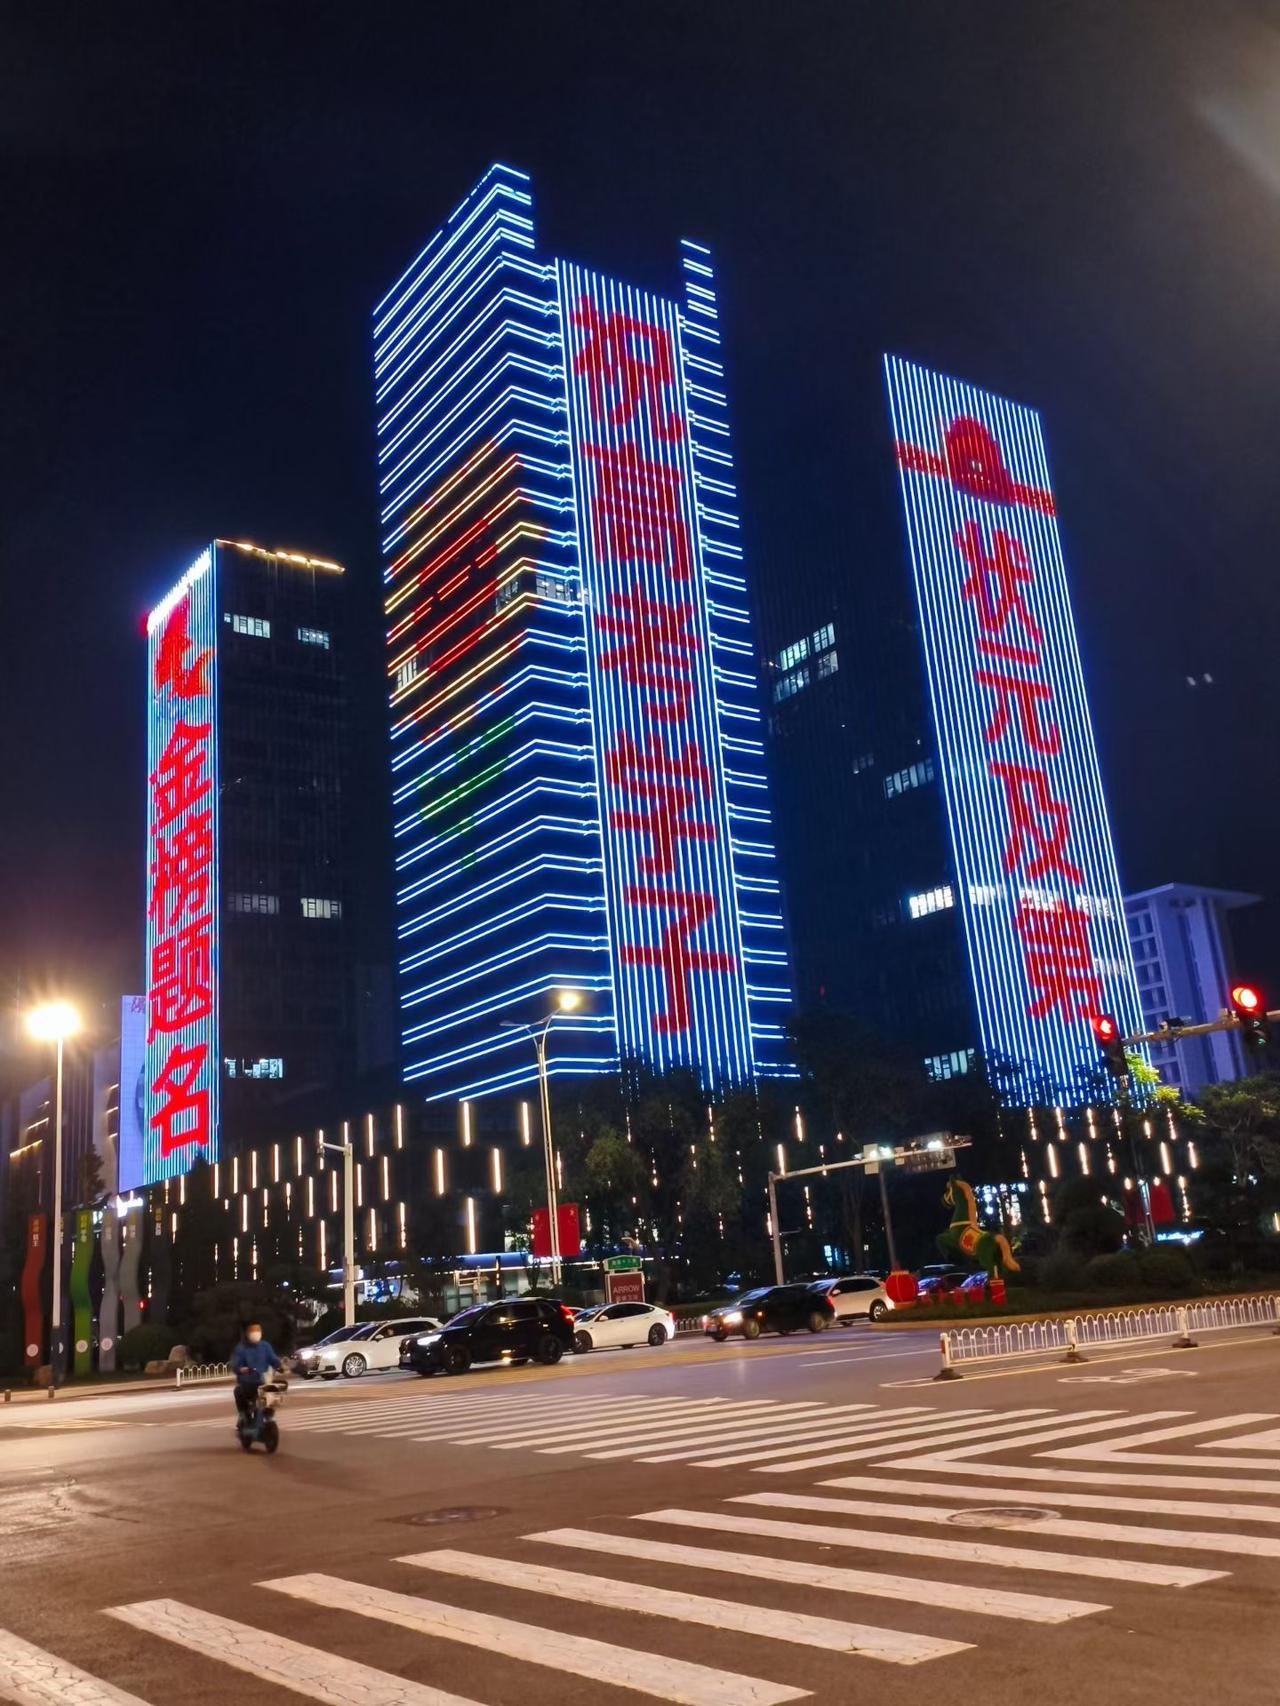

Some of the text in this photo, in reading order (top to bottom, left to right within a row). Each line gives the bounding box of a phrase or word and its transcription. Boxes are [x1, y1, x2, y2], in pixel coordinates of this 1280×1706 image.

[573, 296, 733, 1036] 祝高考学子
[953, 520, 1102, 1026] 状元及第
[147, 720, 213, 1158] 金榜题名
[613, 1285, 640, 1294] ARROW
